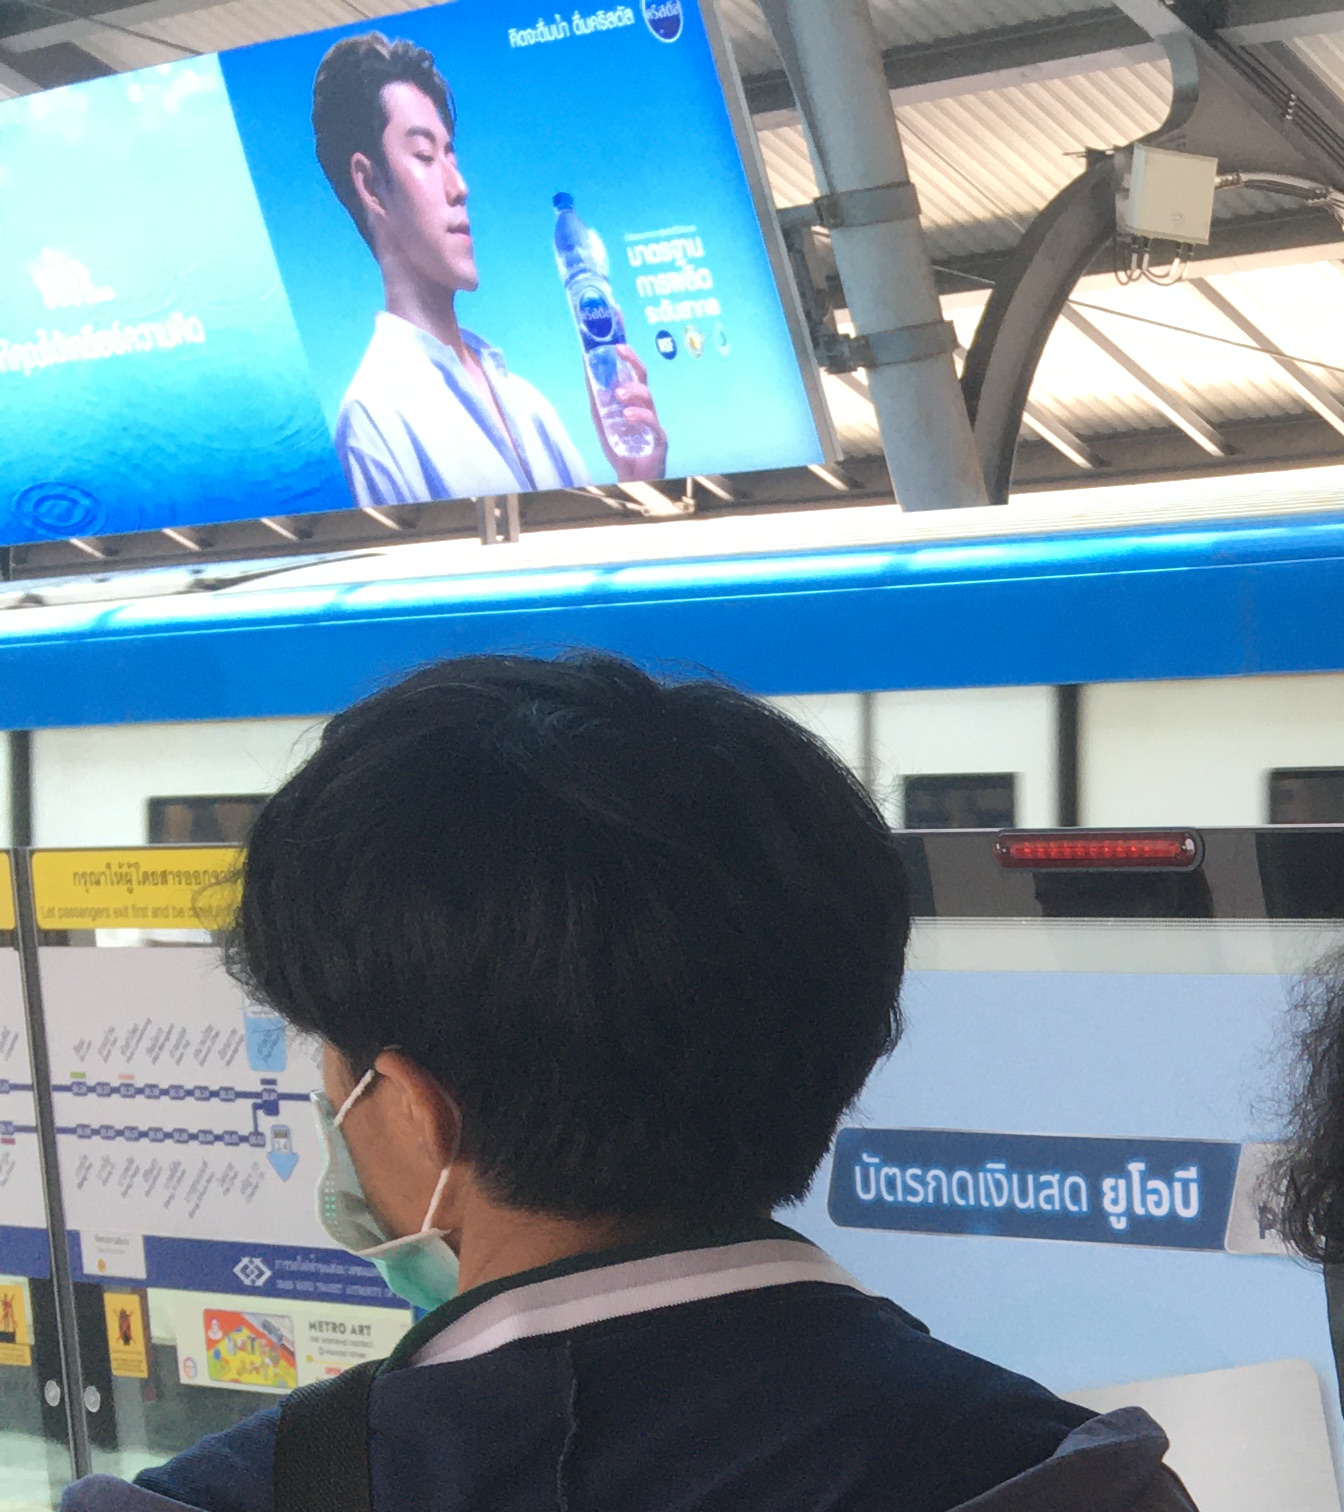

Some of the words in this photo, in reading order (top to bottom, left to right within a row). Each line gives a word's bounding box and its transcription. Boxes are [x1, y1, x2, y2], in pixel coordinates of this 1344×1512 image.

[853, 1152, 1089, 1213] บัตรกดเงินสด
[1100, 1160, 1201, 1230] ยูโอบี
[308, 1319, 347, 1335] METRO
[350, 1323, 372, 1337] ART
